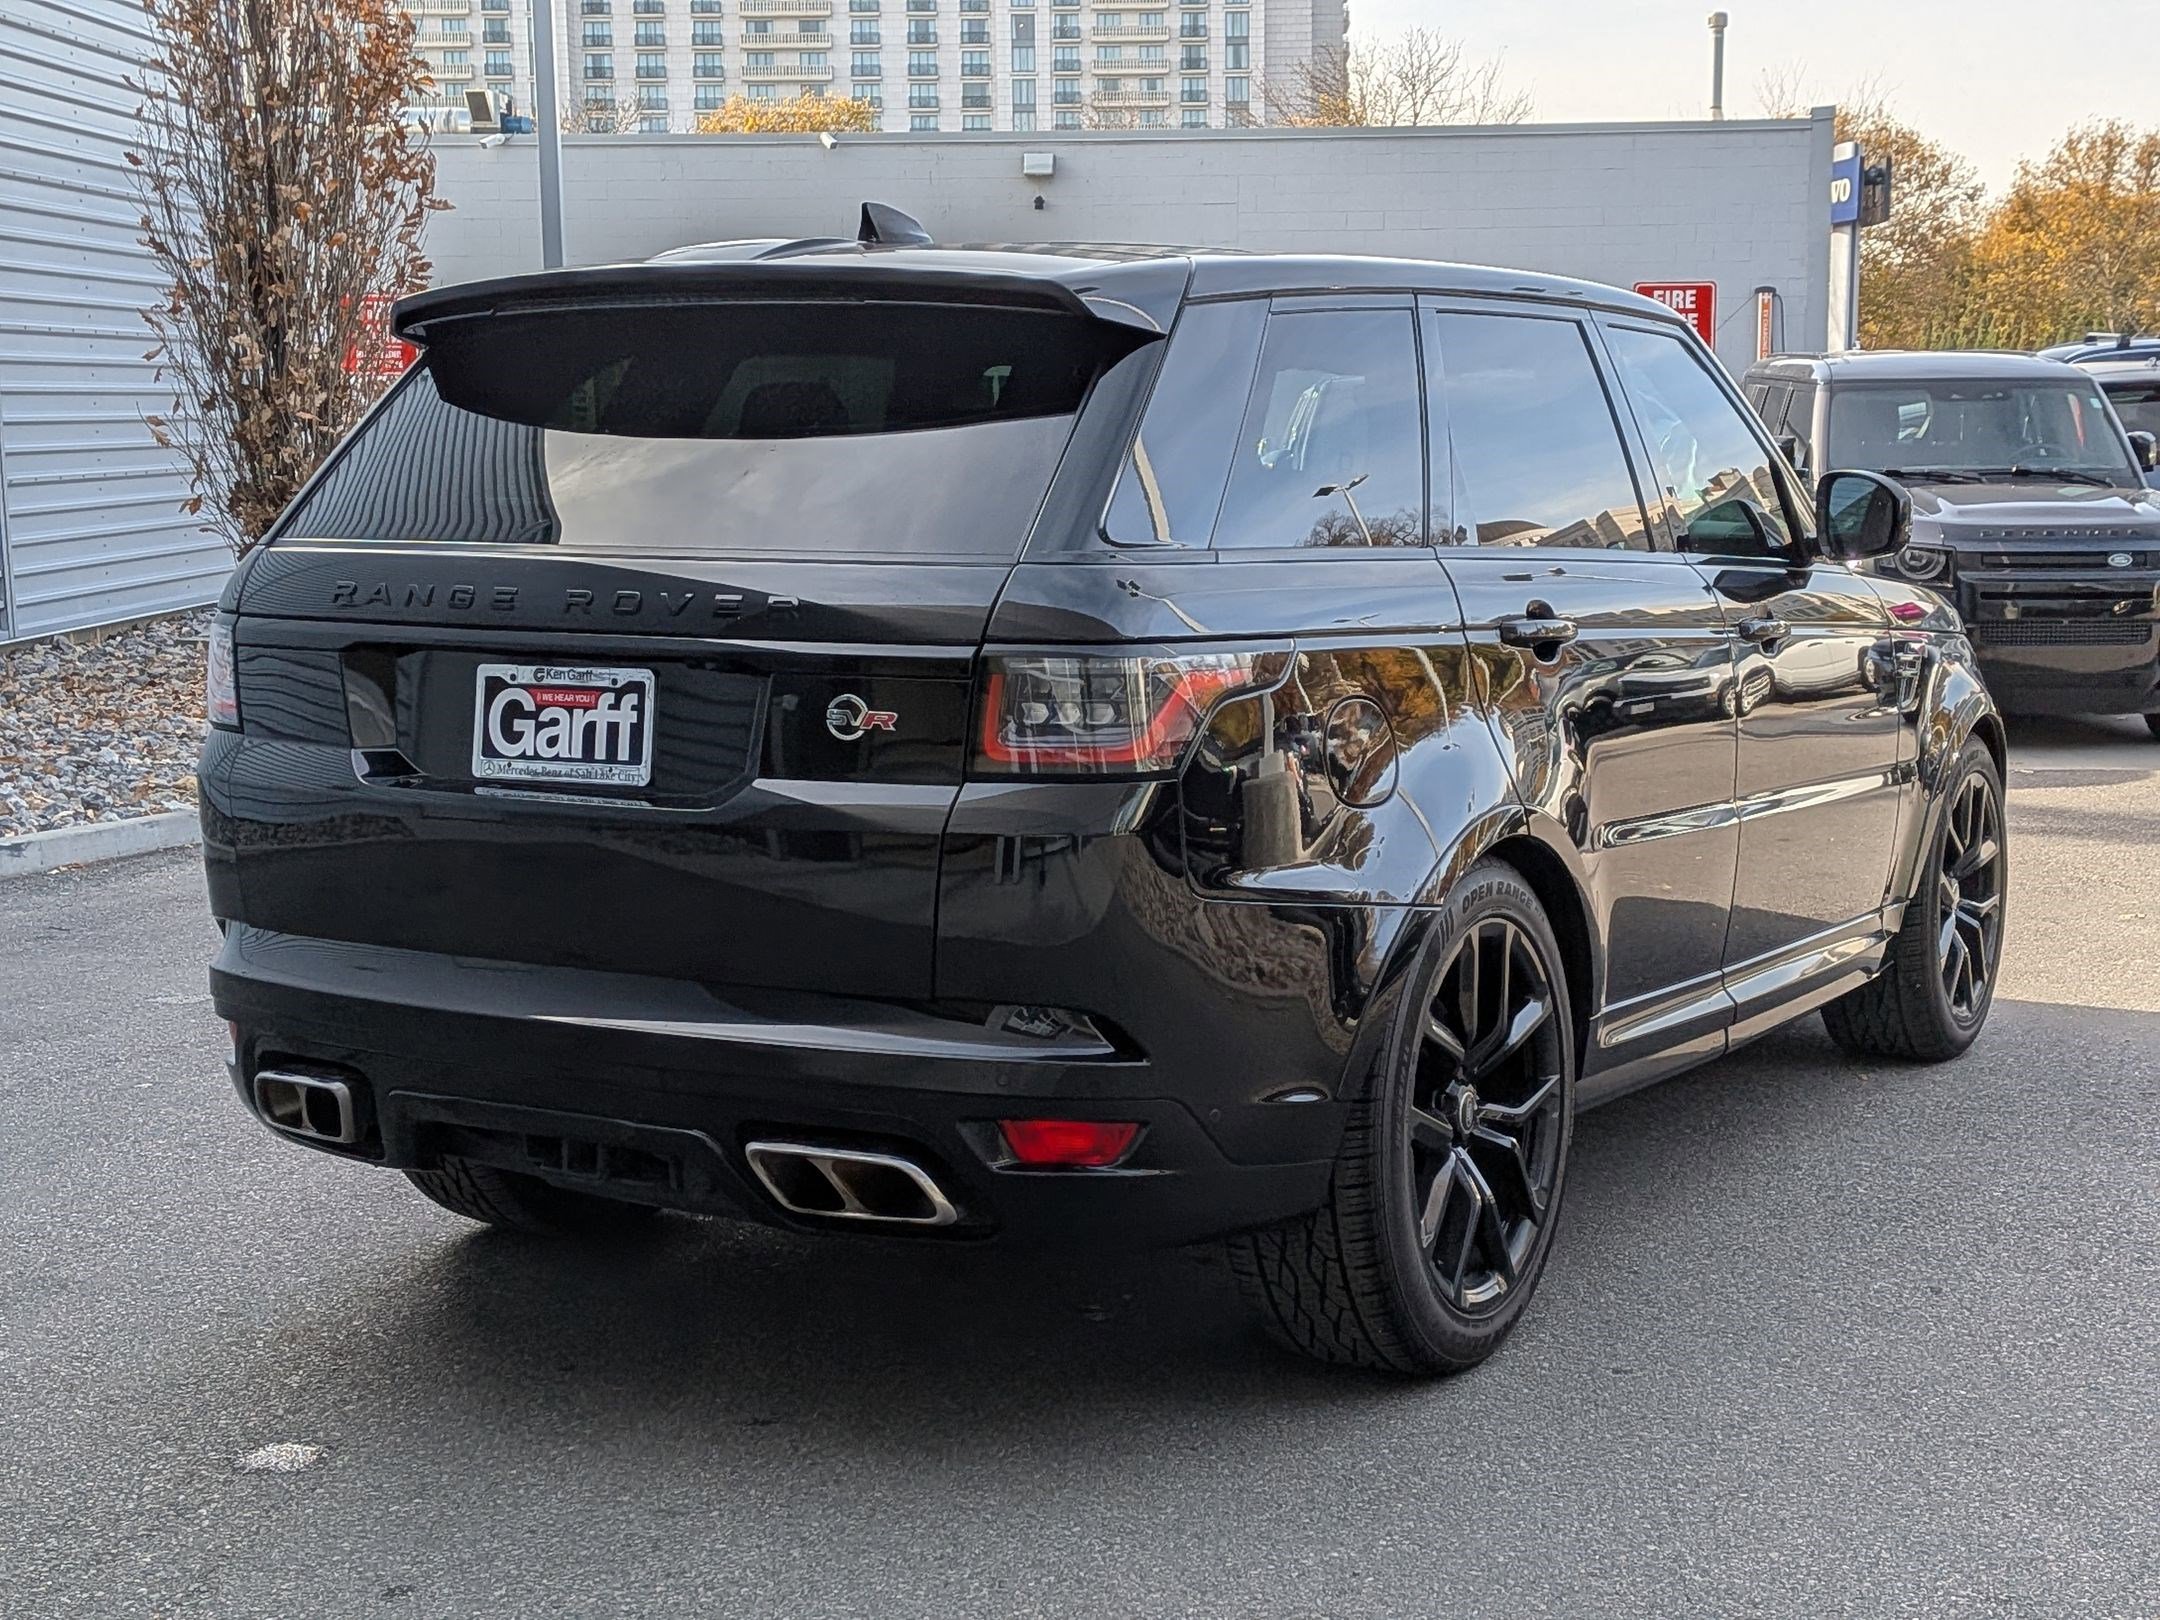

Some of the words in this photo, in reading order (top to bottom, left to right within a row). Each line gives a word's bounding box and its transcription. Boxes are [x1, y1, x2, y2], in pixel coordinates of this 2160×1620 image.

[332, 580, 519, 611] RANGE
[563, 588, 800, 619] ROVER
[545, 668, 567, 680] Ken
[542, 694, 553, 702] WE
[554, 694, 575, 702] HEAR
[575, 694, 590, 703] YOU
[488, 688, 638, 761] Garff
[826, 703, 898, 734] SVR
[1462, 882, 1493, 914] OPEN
[1496, 881, 1533, 909] RANGE
